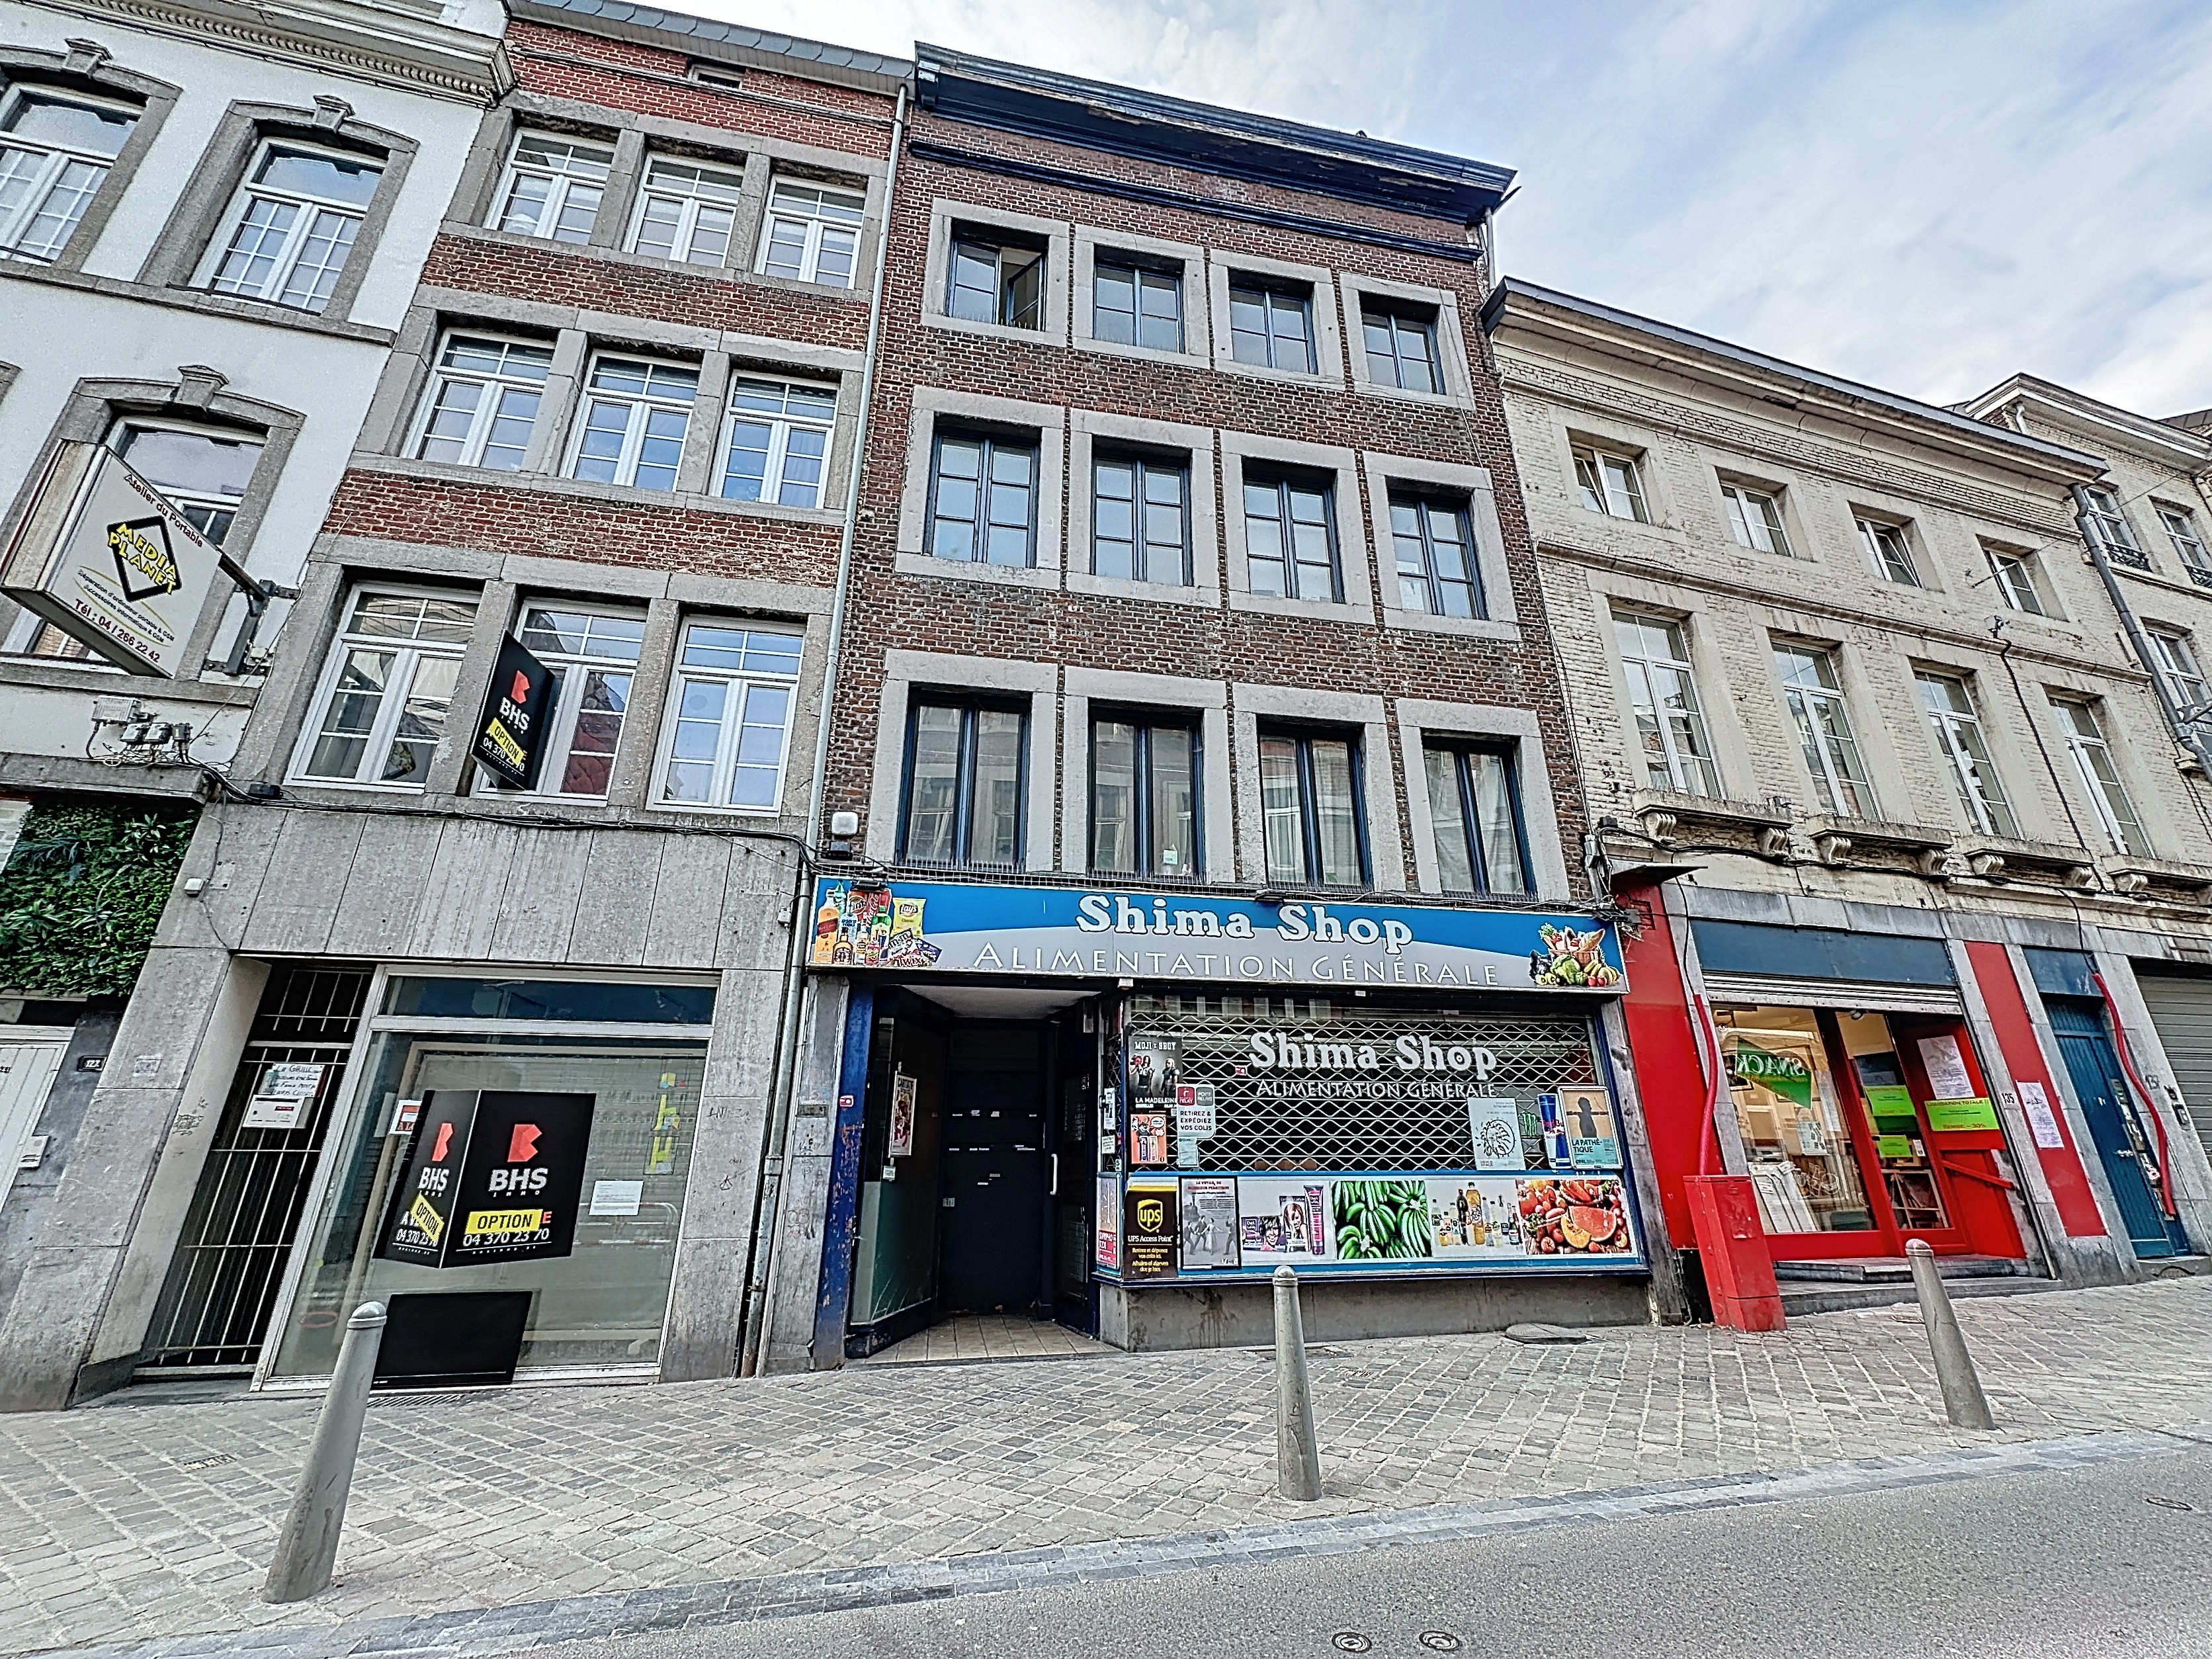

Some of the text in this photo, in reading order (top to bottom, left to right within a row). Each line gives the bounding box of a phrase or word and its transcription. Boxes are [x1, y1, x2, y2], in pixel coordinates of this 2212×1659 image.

[124, 474, 203, 547] Atelier du Portable
[116, 523, 177, 579] MEDIA
[108, 532, 177, 595] PLANET
[99, 616, 111, 630] 04
[116, 629, 135, 646] 266
[135, 642, 148, 654] 22
[148, 650, 160, 663] 42
[163, 630, 175, 641] GSM
[499, 697, 529, 732] BHS
[483, 737, 492, 750] 04
[492, 744, 505, 758] 370
[494, 725, 520, 759] OPTION
[1076, 894, 1414, 955] Shima Shop
[973, 942, 1498, 986] ALIMENTATION GÉNÉRALE
[1134, 1041, 1152, 1050] MOJI
[1249, 1032, 1497, 1080] Shima Shop
[1256, 1078, 1497, 1099] ALIMENTATION GÉNÉRALE
[2002, 1093, 2015, 1104] 135
[418, 1167, 450, 1191] BHS
[488, 1168, 549, 1191] BHS
[417, 1203, 439, 1236] OPTION
[477, 1214, 533, 1229] OPTION
[1140, 1209, 1161, 1227] ups
[396, 1228, 407, 1242] 04
[407, 1230, 419, 1244] 370
[463, 1228, 550, 1247] 04 370 23 70
